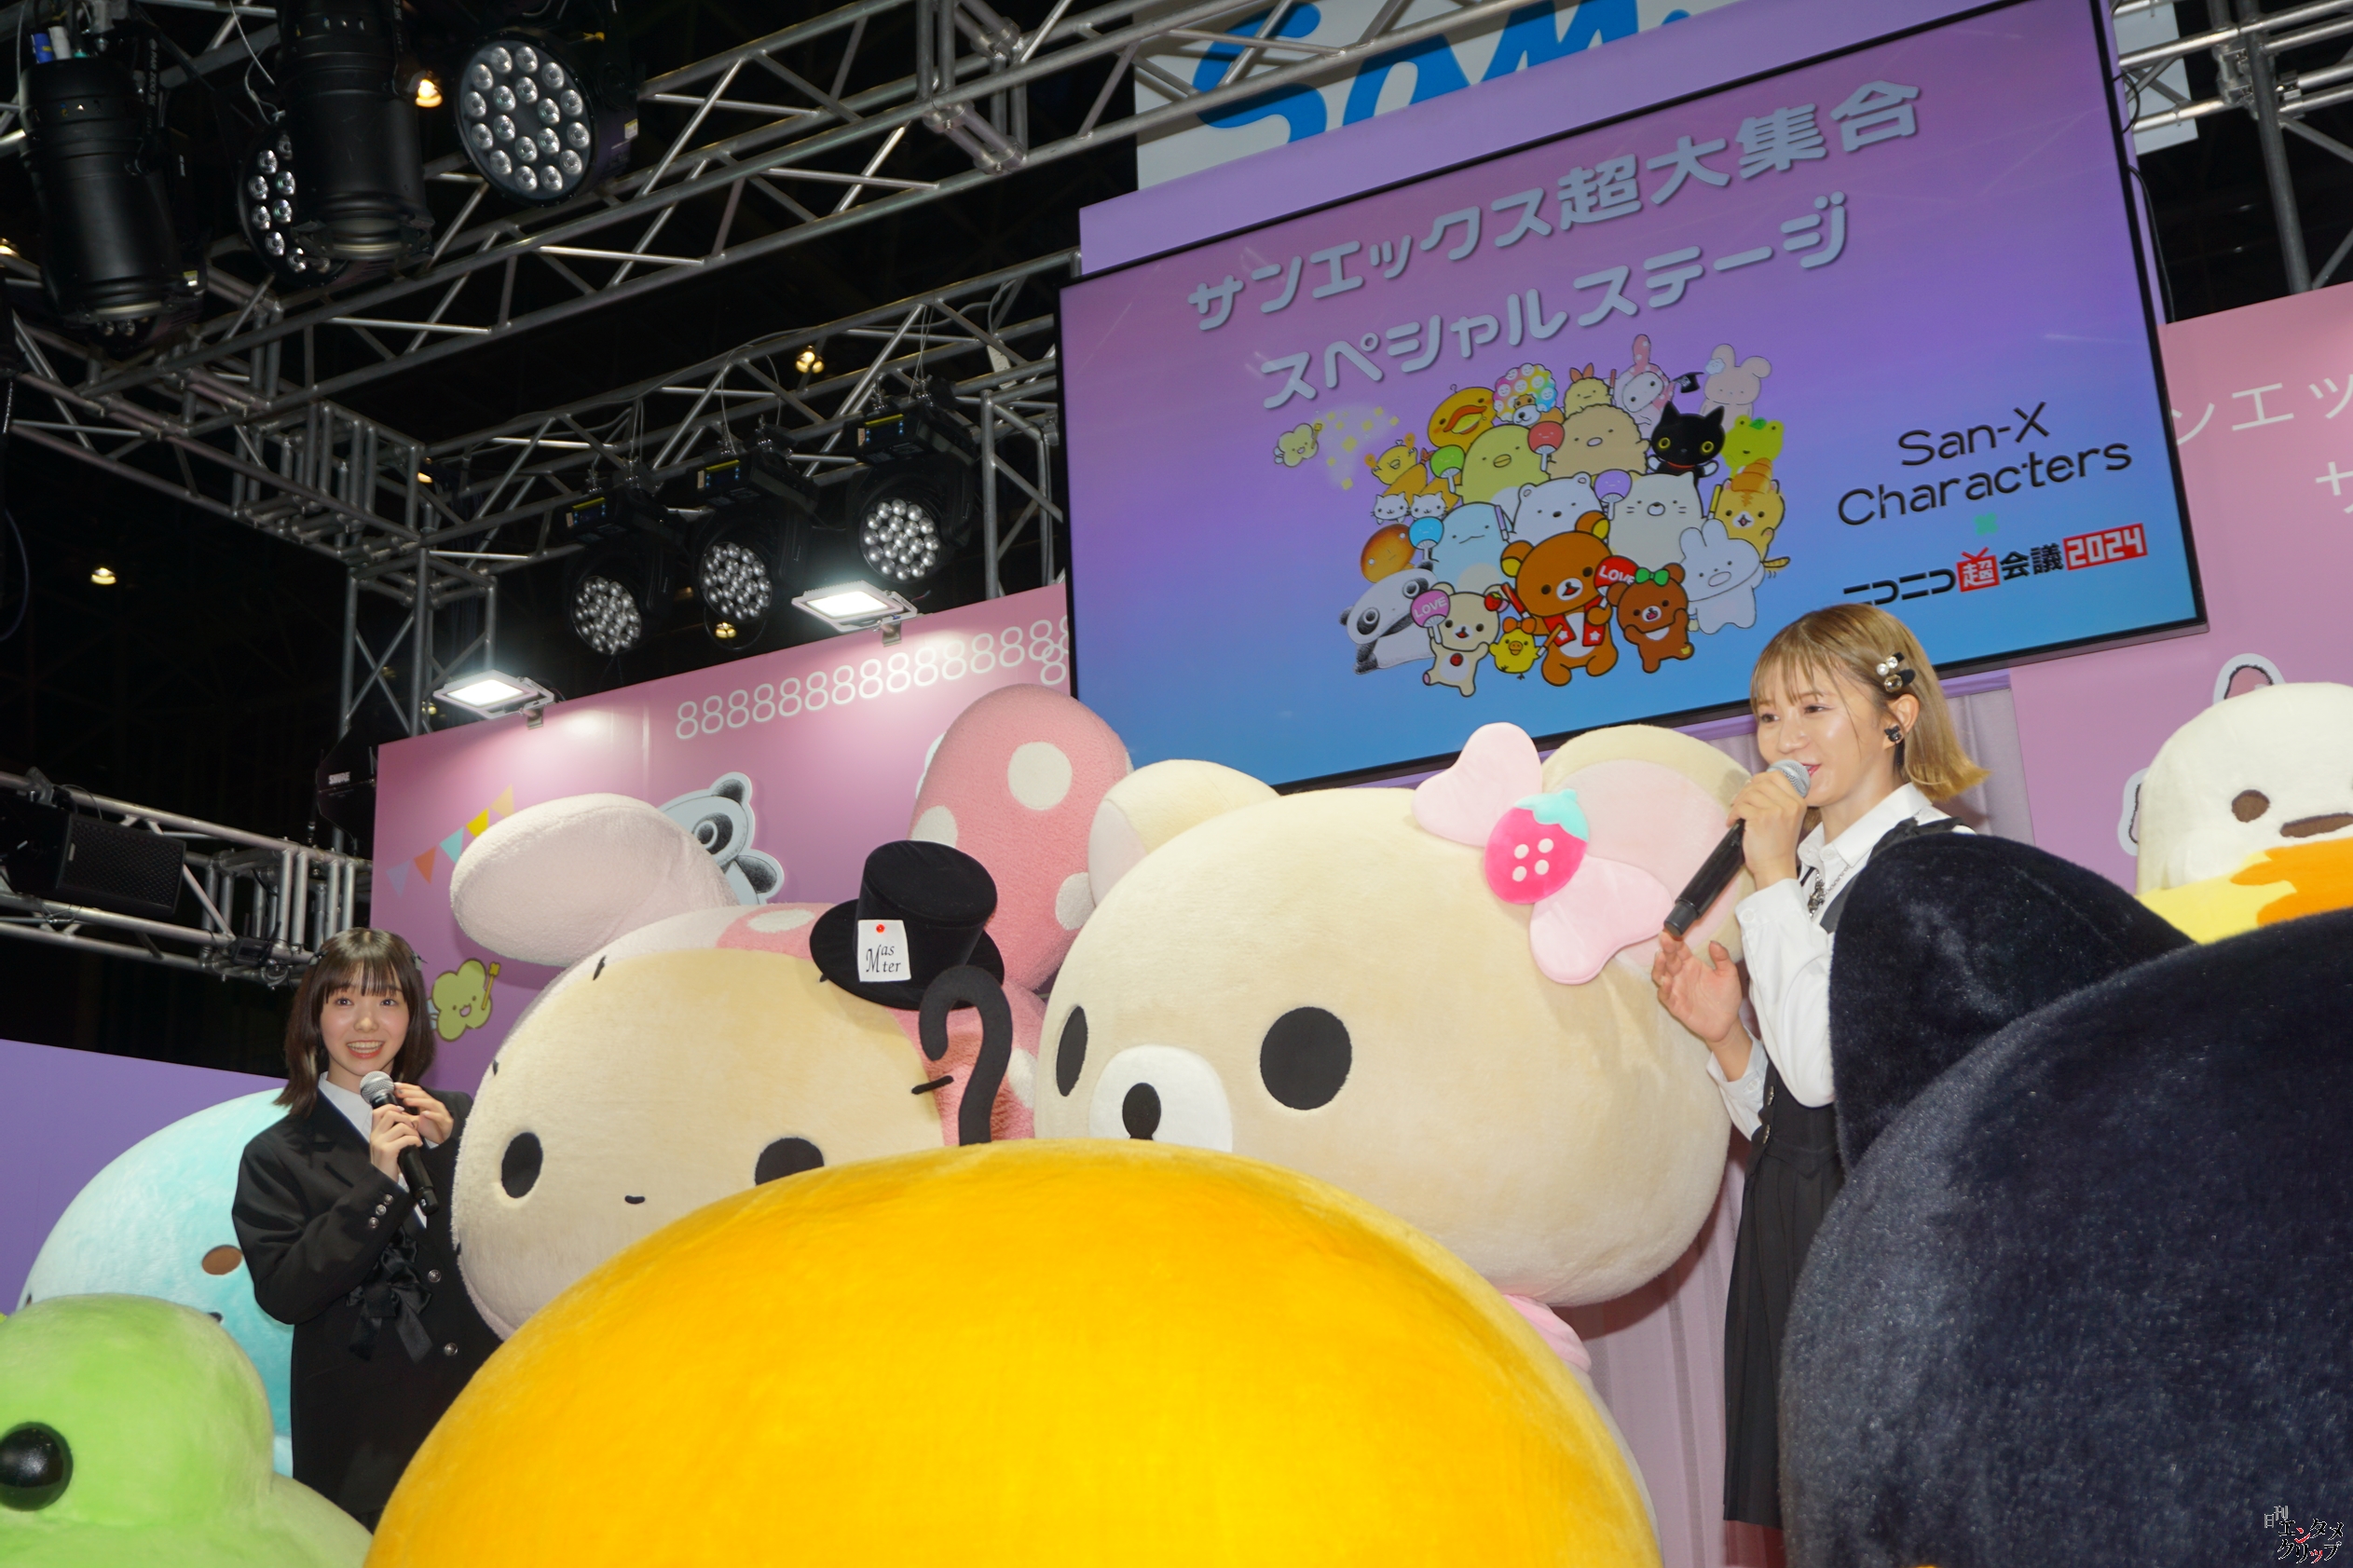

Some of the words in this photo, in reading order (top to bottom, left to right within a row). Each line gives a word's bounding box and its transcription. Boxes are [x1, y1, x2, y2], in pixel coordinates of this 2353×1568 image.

[1188, 79, 1920, 330] サンエックス超大集合
[1261, 190, 1845, 408] スペシャルステージ
[1897, 401, 2050, 466] San-X
[1838, 442, 2132, 525] Characters
[1414, 596, 1448, 619] LOVE
[1599, 565, 1635, 585] LOVE
